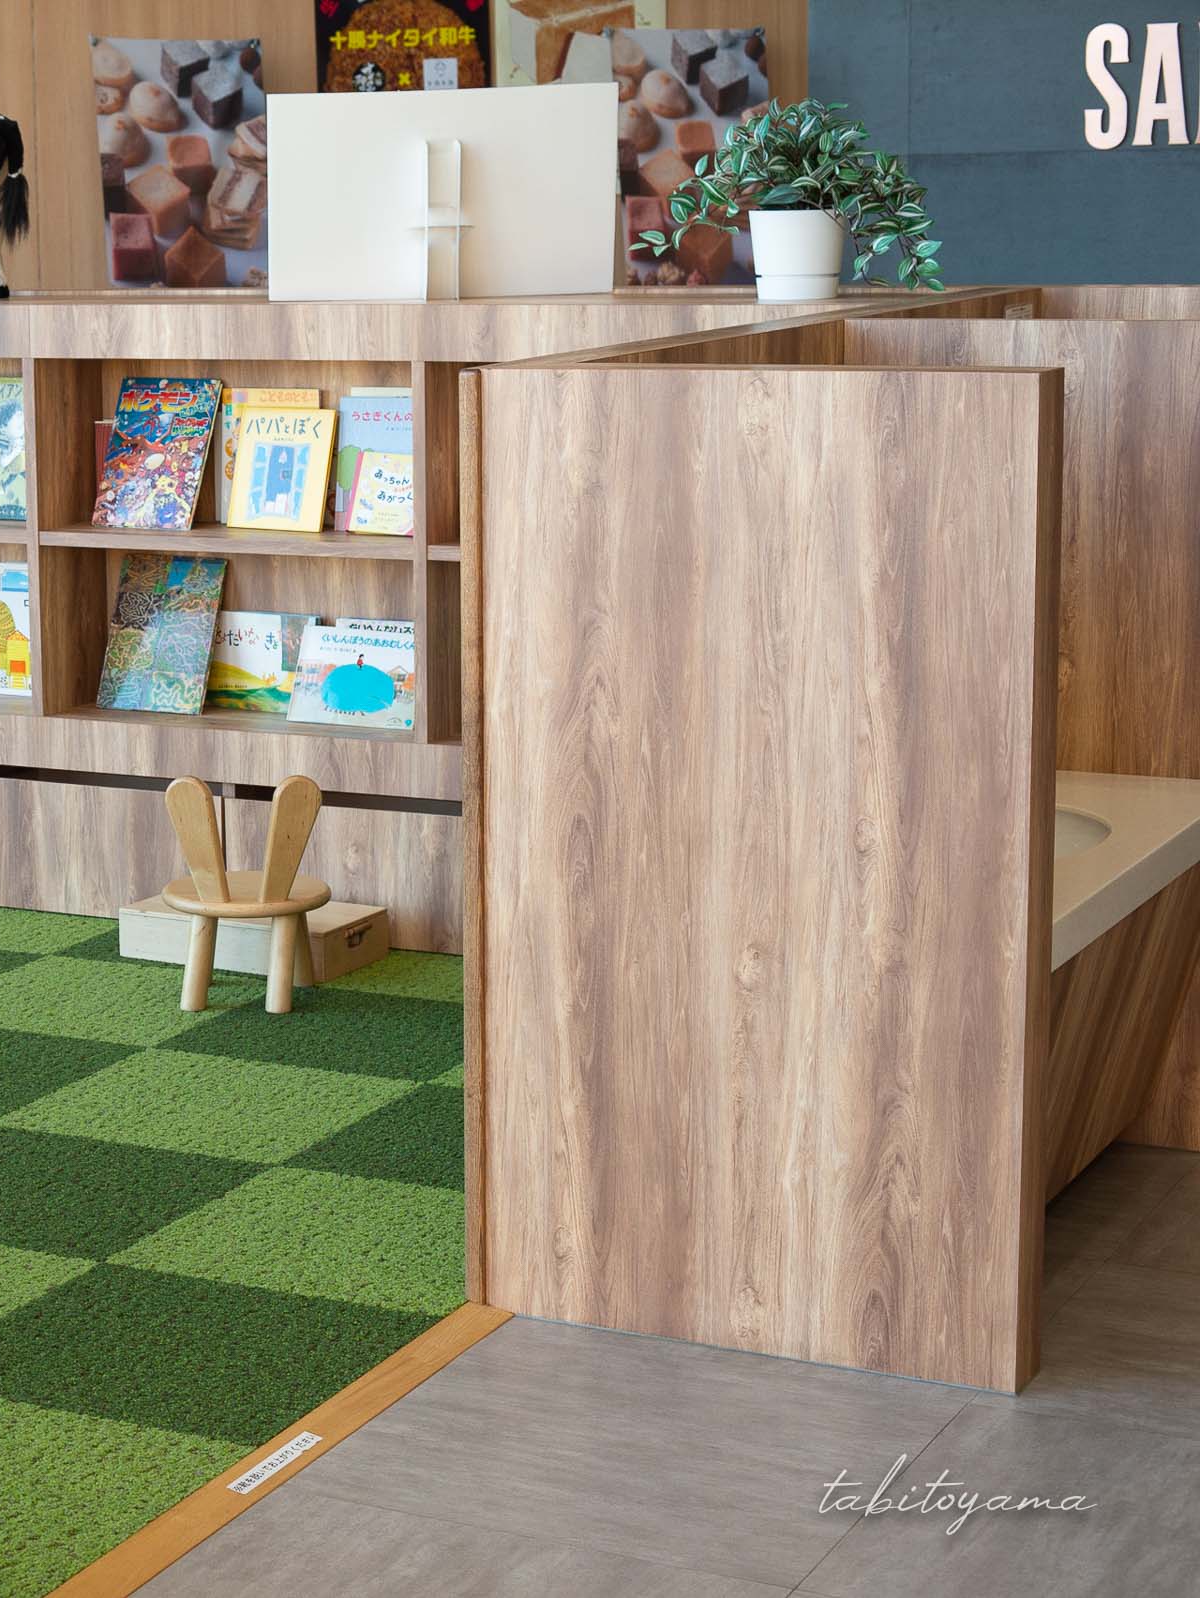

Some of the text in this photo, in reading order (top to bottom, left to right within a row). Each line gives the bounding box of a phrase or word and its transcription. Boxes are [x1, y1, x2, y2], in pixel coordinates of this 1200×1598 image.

[329, 26, 476, 50] 十勝ナイタイ和牛
[1084, 22, 1200, 150] SA
[119, 390, 198, 412] ポケモン
[246, 416, 321, 439] パパとぼく
